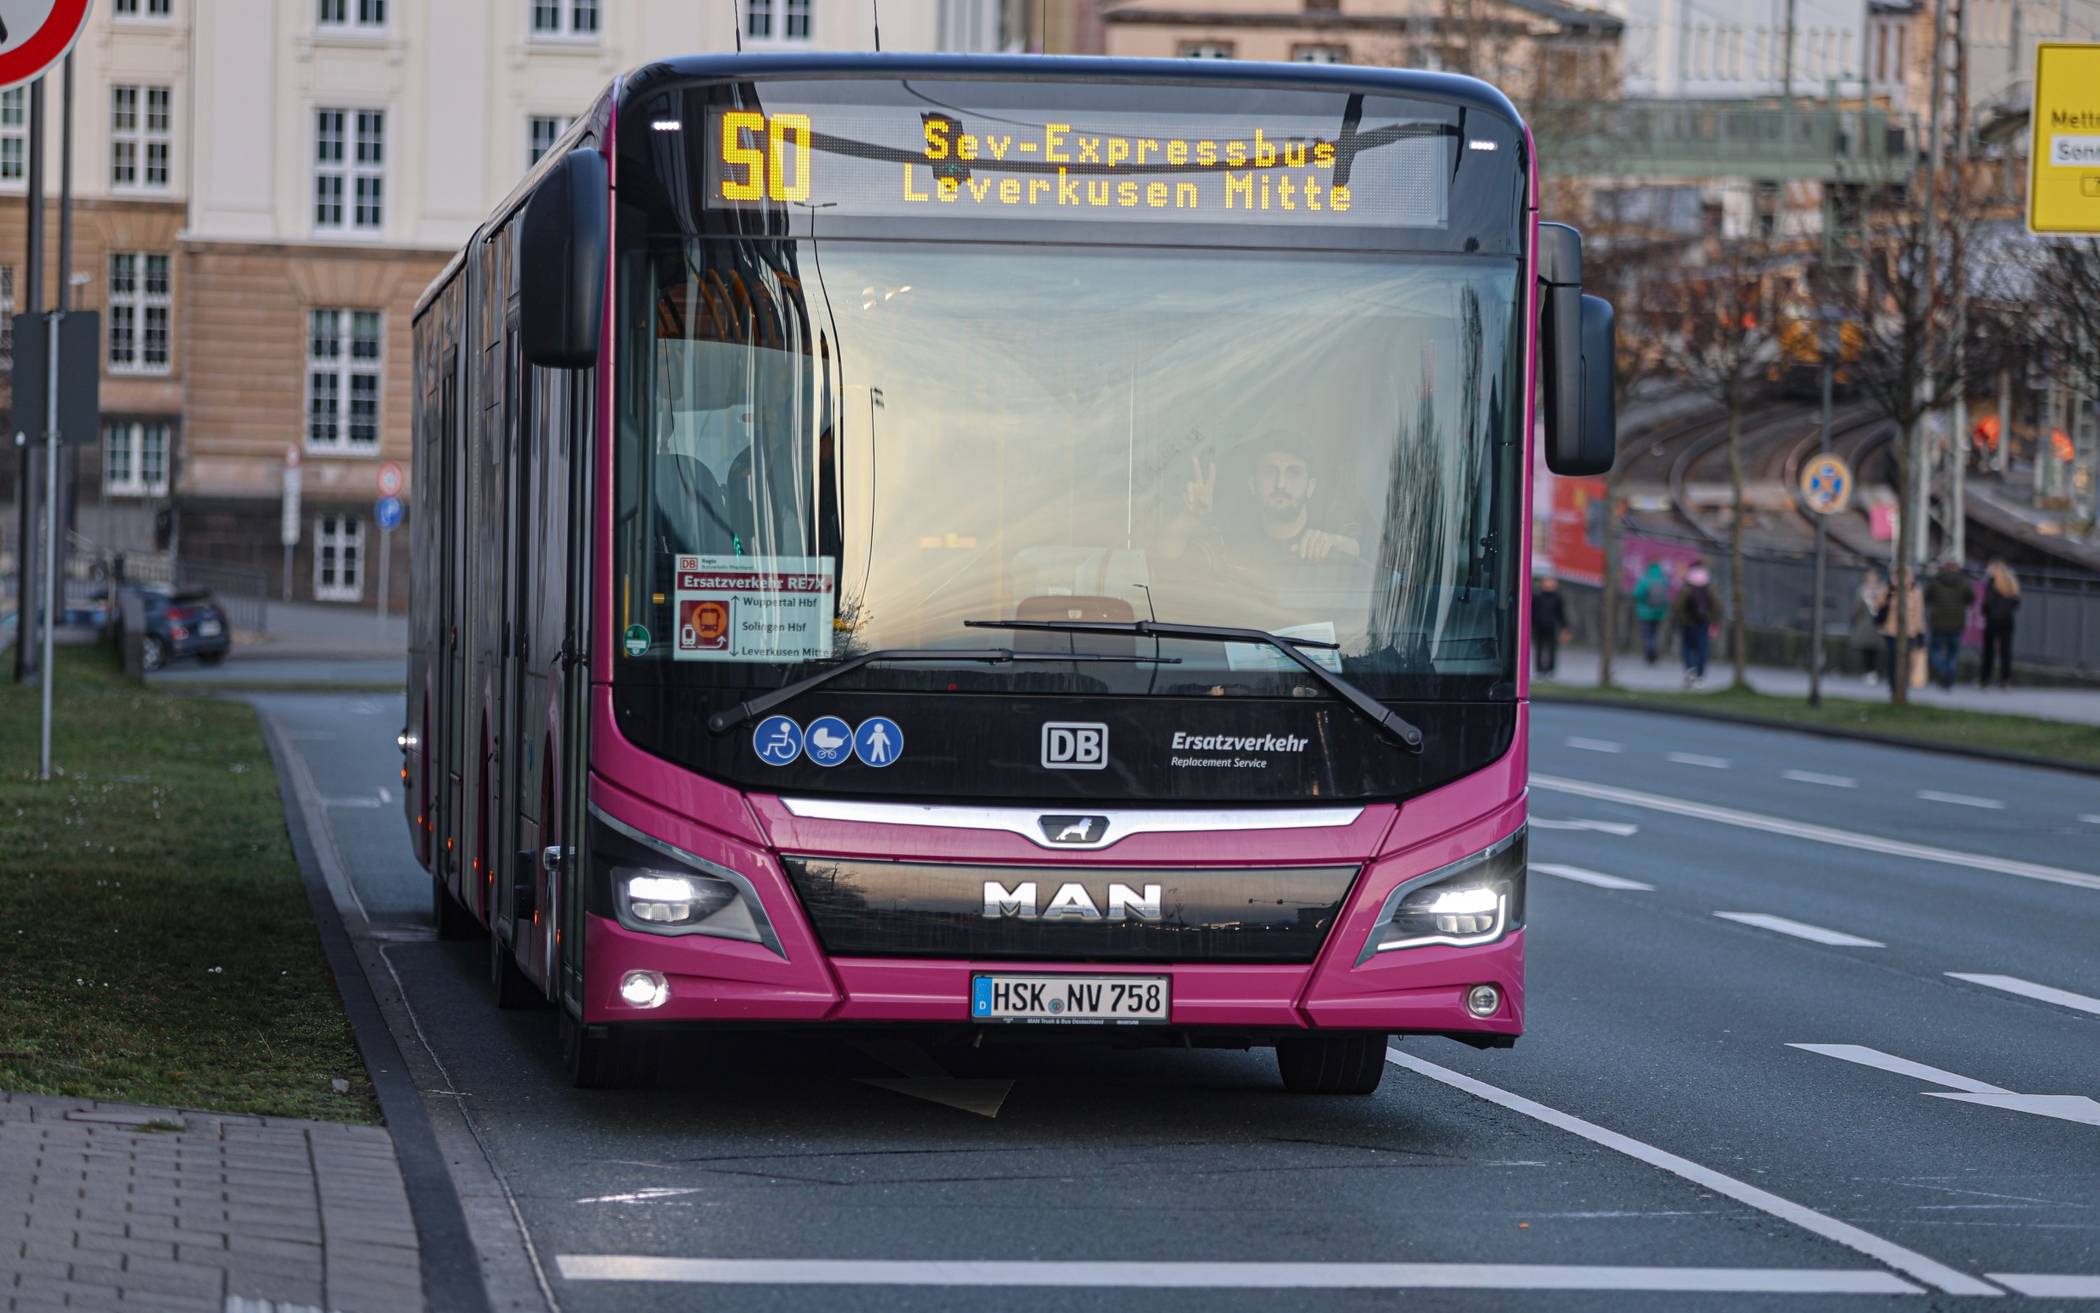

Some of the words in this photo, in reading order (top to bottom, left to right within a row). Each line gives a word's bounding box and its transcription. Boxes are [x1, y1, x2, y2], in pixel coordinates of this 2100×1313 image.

[2051, 109, 2100, 129] Mett
[925, 119, 1335, 168] Sev-Expressbus
[904, 161, 1198, 208] Leverkusen
[1225, 171, 1351, 211] Mitte
[682, 559, 696, 569] DB
[684, 575, 783, 589] Ersatzverkehr
[788, 578, 824, 590] RE7X
[743, 597, 796, 608] Wuppertal
[799, 599, 817, 607] Hbf
[742, 621, 785, 633] Solingen
[788, 623, 807, 632] Hbf
[742, 646, 799, 657] Leverkusen
[1050, 730, 1100, 762] DB
[1171, 732, 1308, 752] Ersatzverkehr
[1171, 756, 1231, 768] Replacement
[1233, 758, 1267, 768] Service
[983, 881, 1162, 919] MAN
[993, 983, 1046, 1012] HSK
[1067, 985, 1102, 1012] NV
[1110, 984, 1161, 1013] 758
